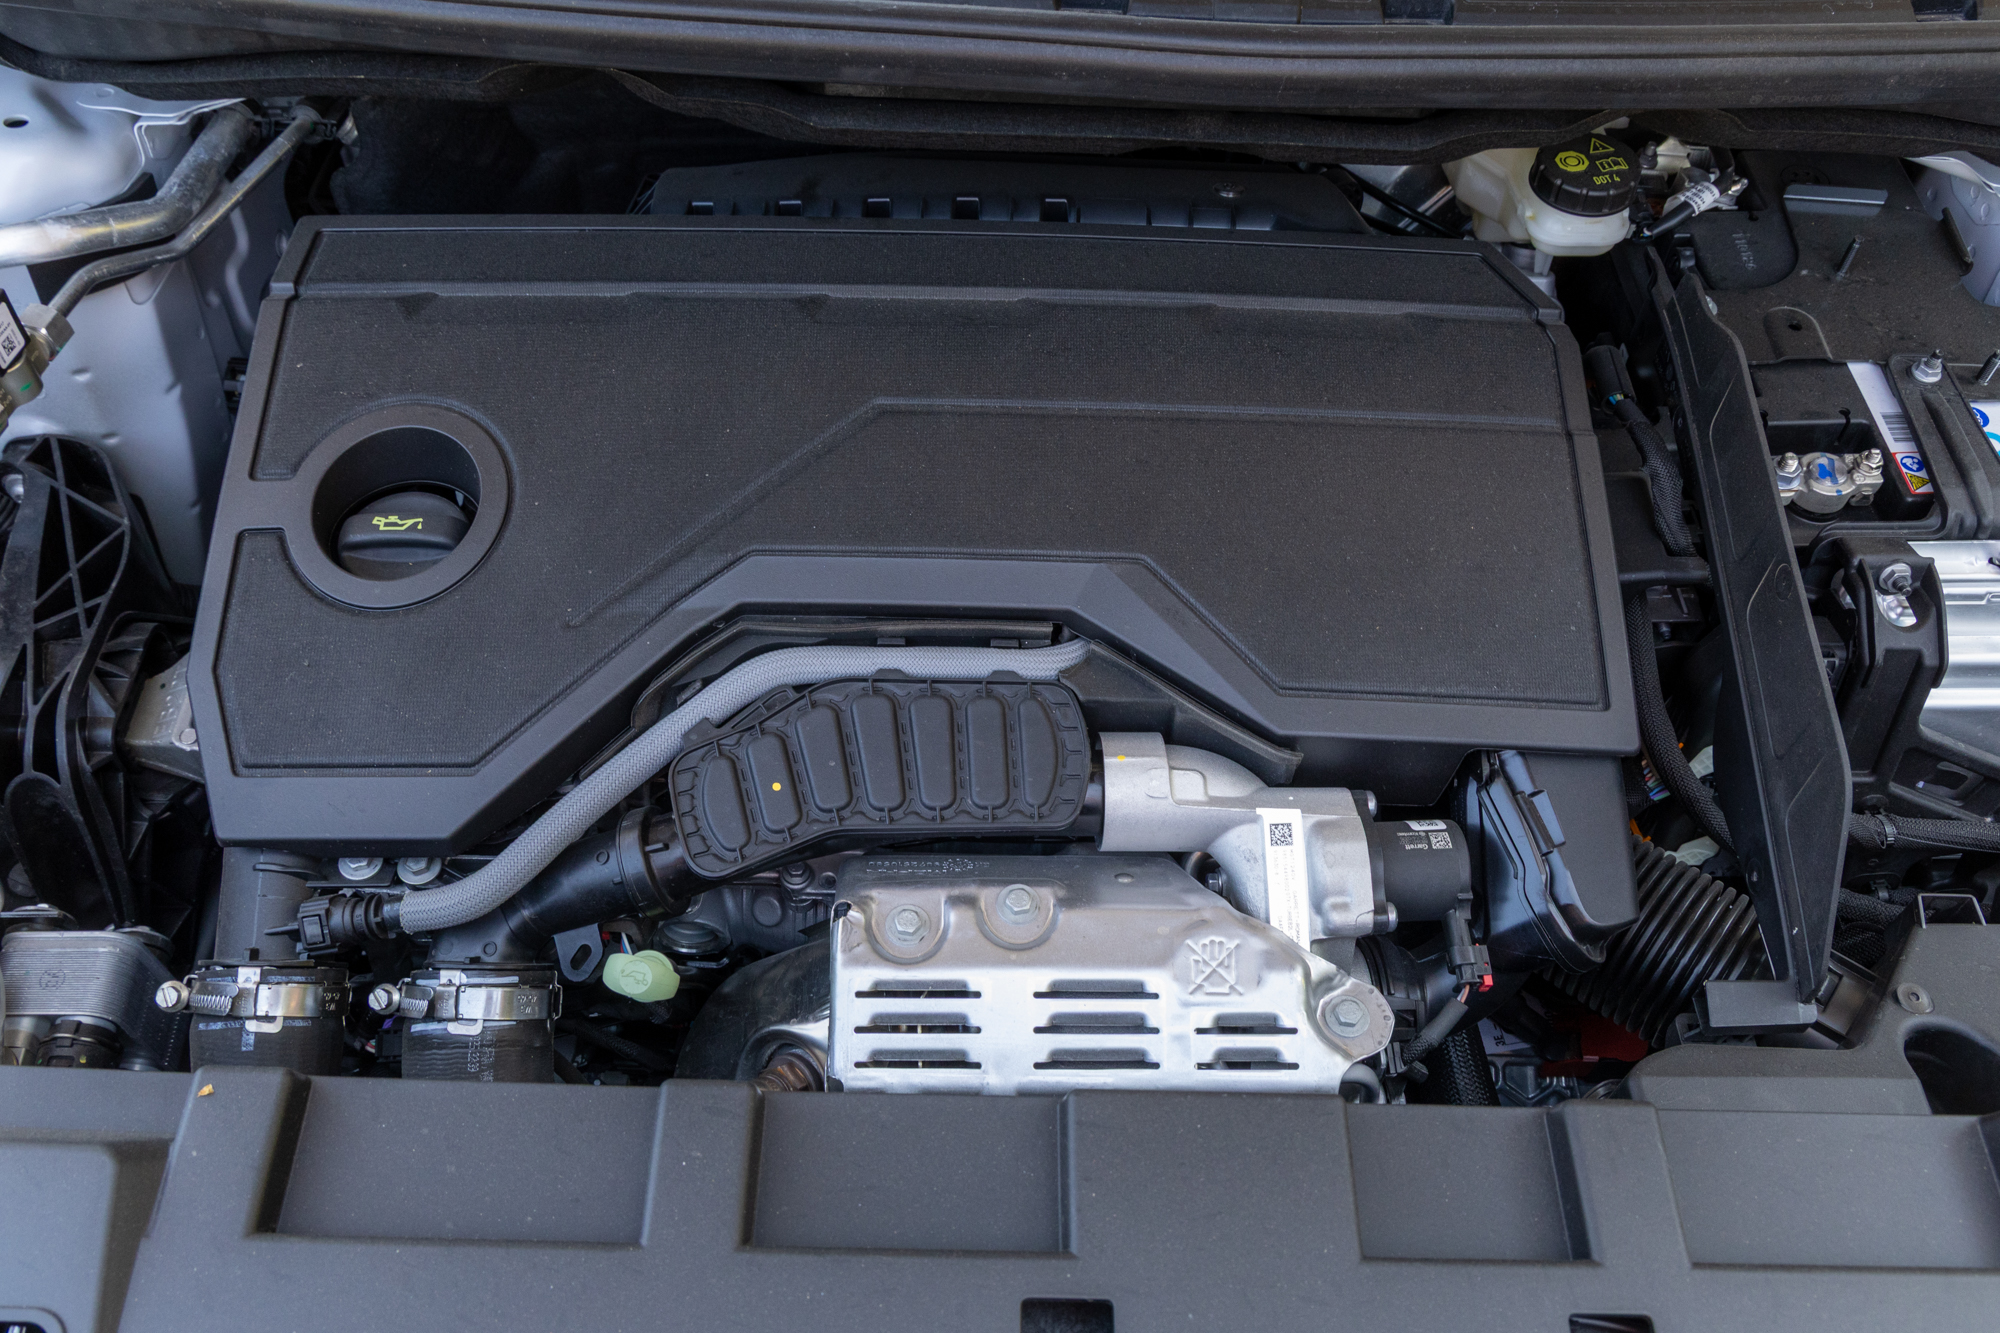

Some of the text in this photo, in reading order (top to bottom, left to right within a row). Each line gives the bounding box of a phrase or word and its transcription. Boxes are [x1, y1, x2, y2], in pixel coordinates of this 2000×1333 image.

[1593, 173, 1621, 185] DOT 4
[1405, 843, 1428, 851] Garrett
